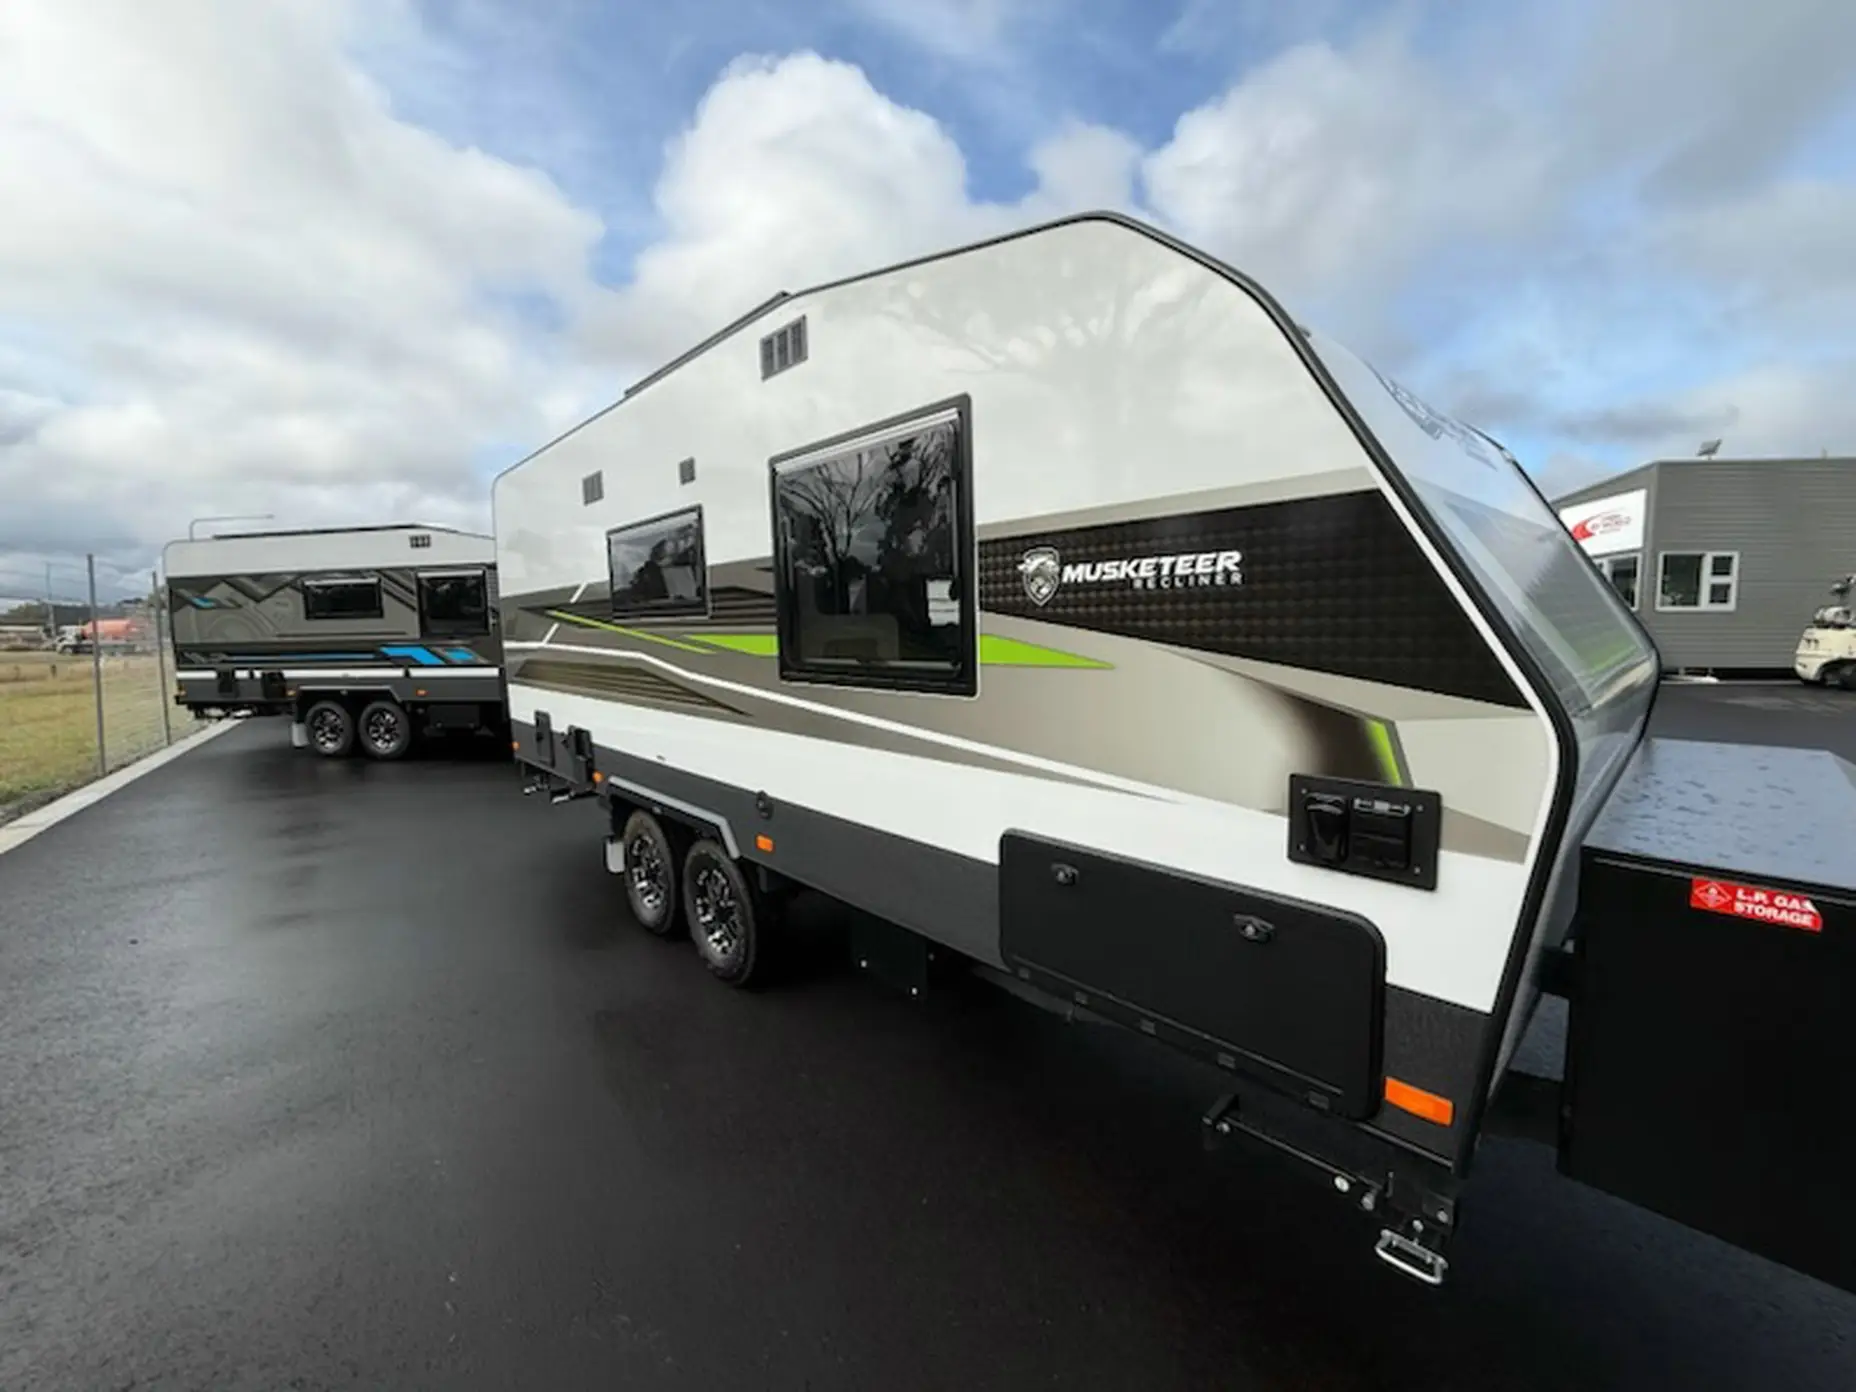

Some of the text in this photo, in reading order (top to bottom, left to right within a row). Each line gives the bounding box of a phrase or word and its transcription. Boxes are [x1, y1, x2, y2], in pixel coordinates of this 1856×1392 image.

[1062, 551, 1242, 583] MUSKETEER
[1133, 572, 1242, 589] RECLINER
[1734, 902, 1813, 926] STORAGE
